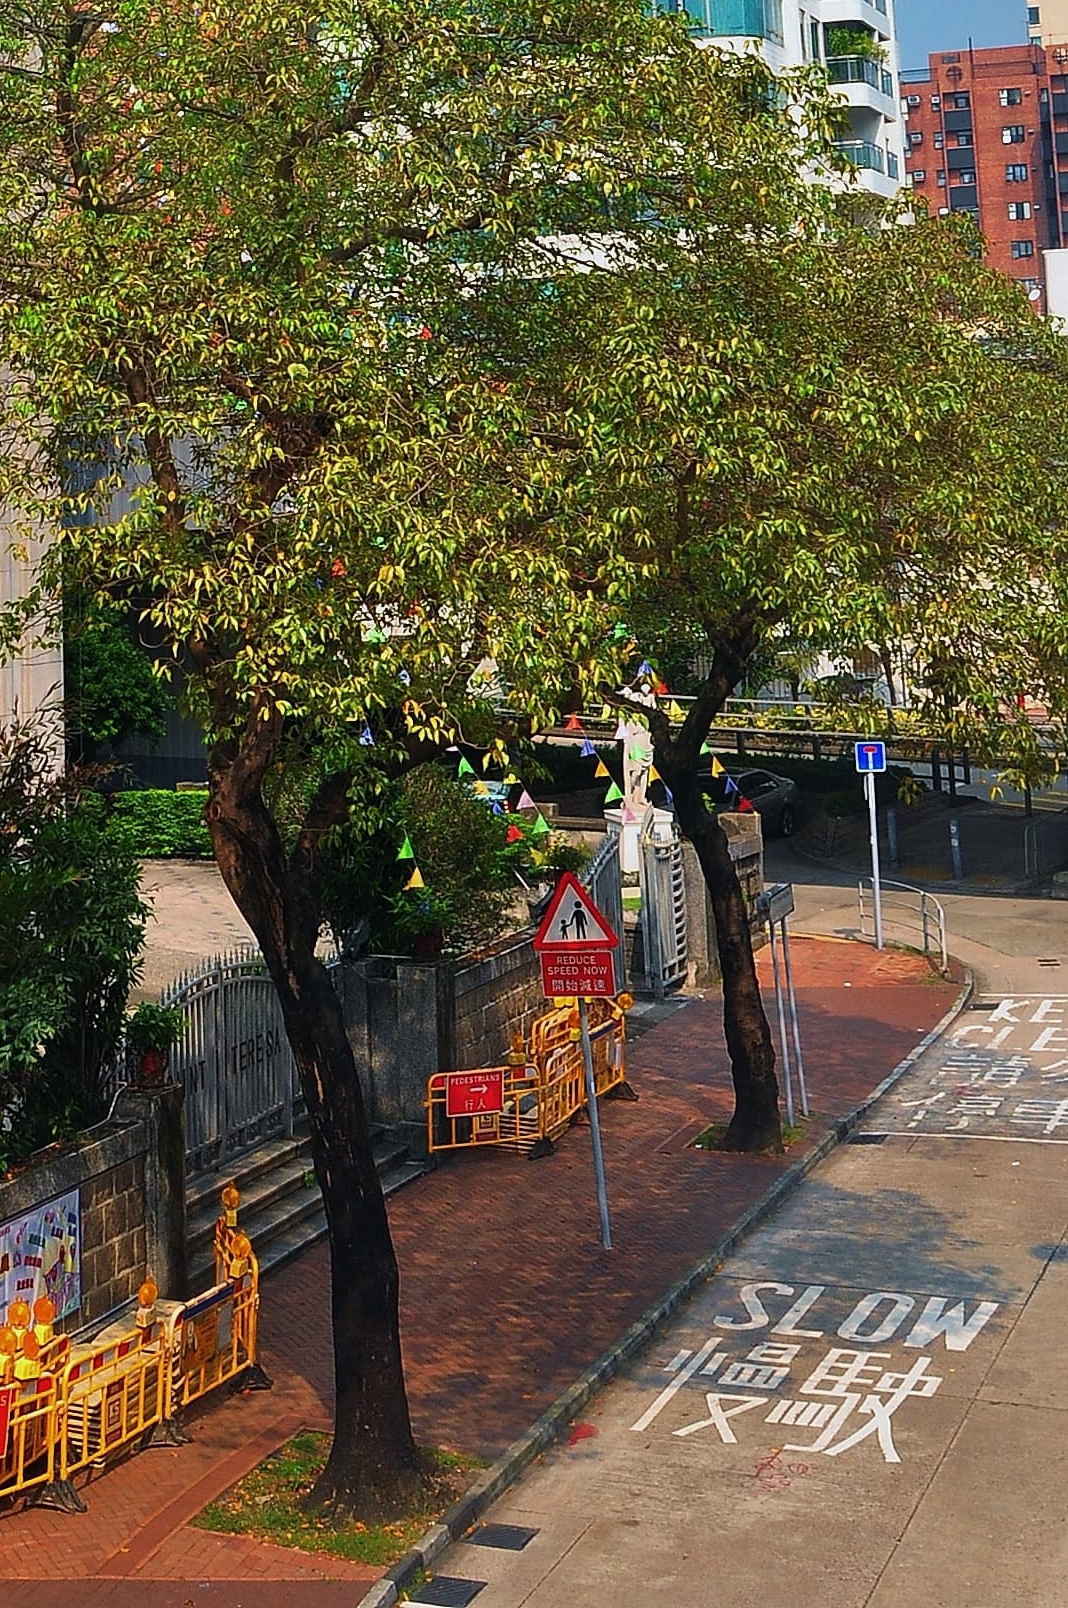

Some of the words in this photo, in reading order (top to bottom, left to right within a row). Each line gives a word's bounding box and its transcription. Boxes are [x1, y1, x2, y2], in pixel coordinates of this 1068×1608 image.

[556, 955, 596, 965] REDUCE
[547, 966, 579, 976] SPEED
[583, 966, 608, 976] NOW
[551, 979, 607, 993] 開始減速
[231, 1026, 282, 1075] TERESA
[450, 1073, 501, 1086] PEDESTRIANS
[464, 1097, 486, 1111] 行人
[712, 1281, 1000, 1352] SLOW
[629, 1337, 943, 1464] 慢駛
